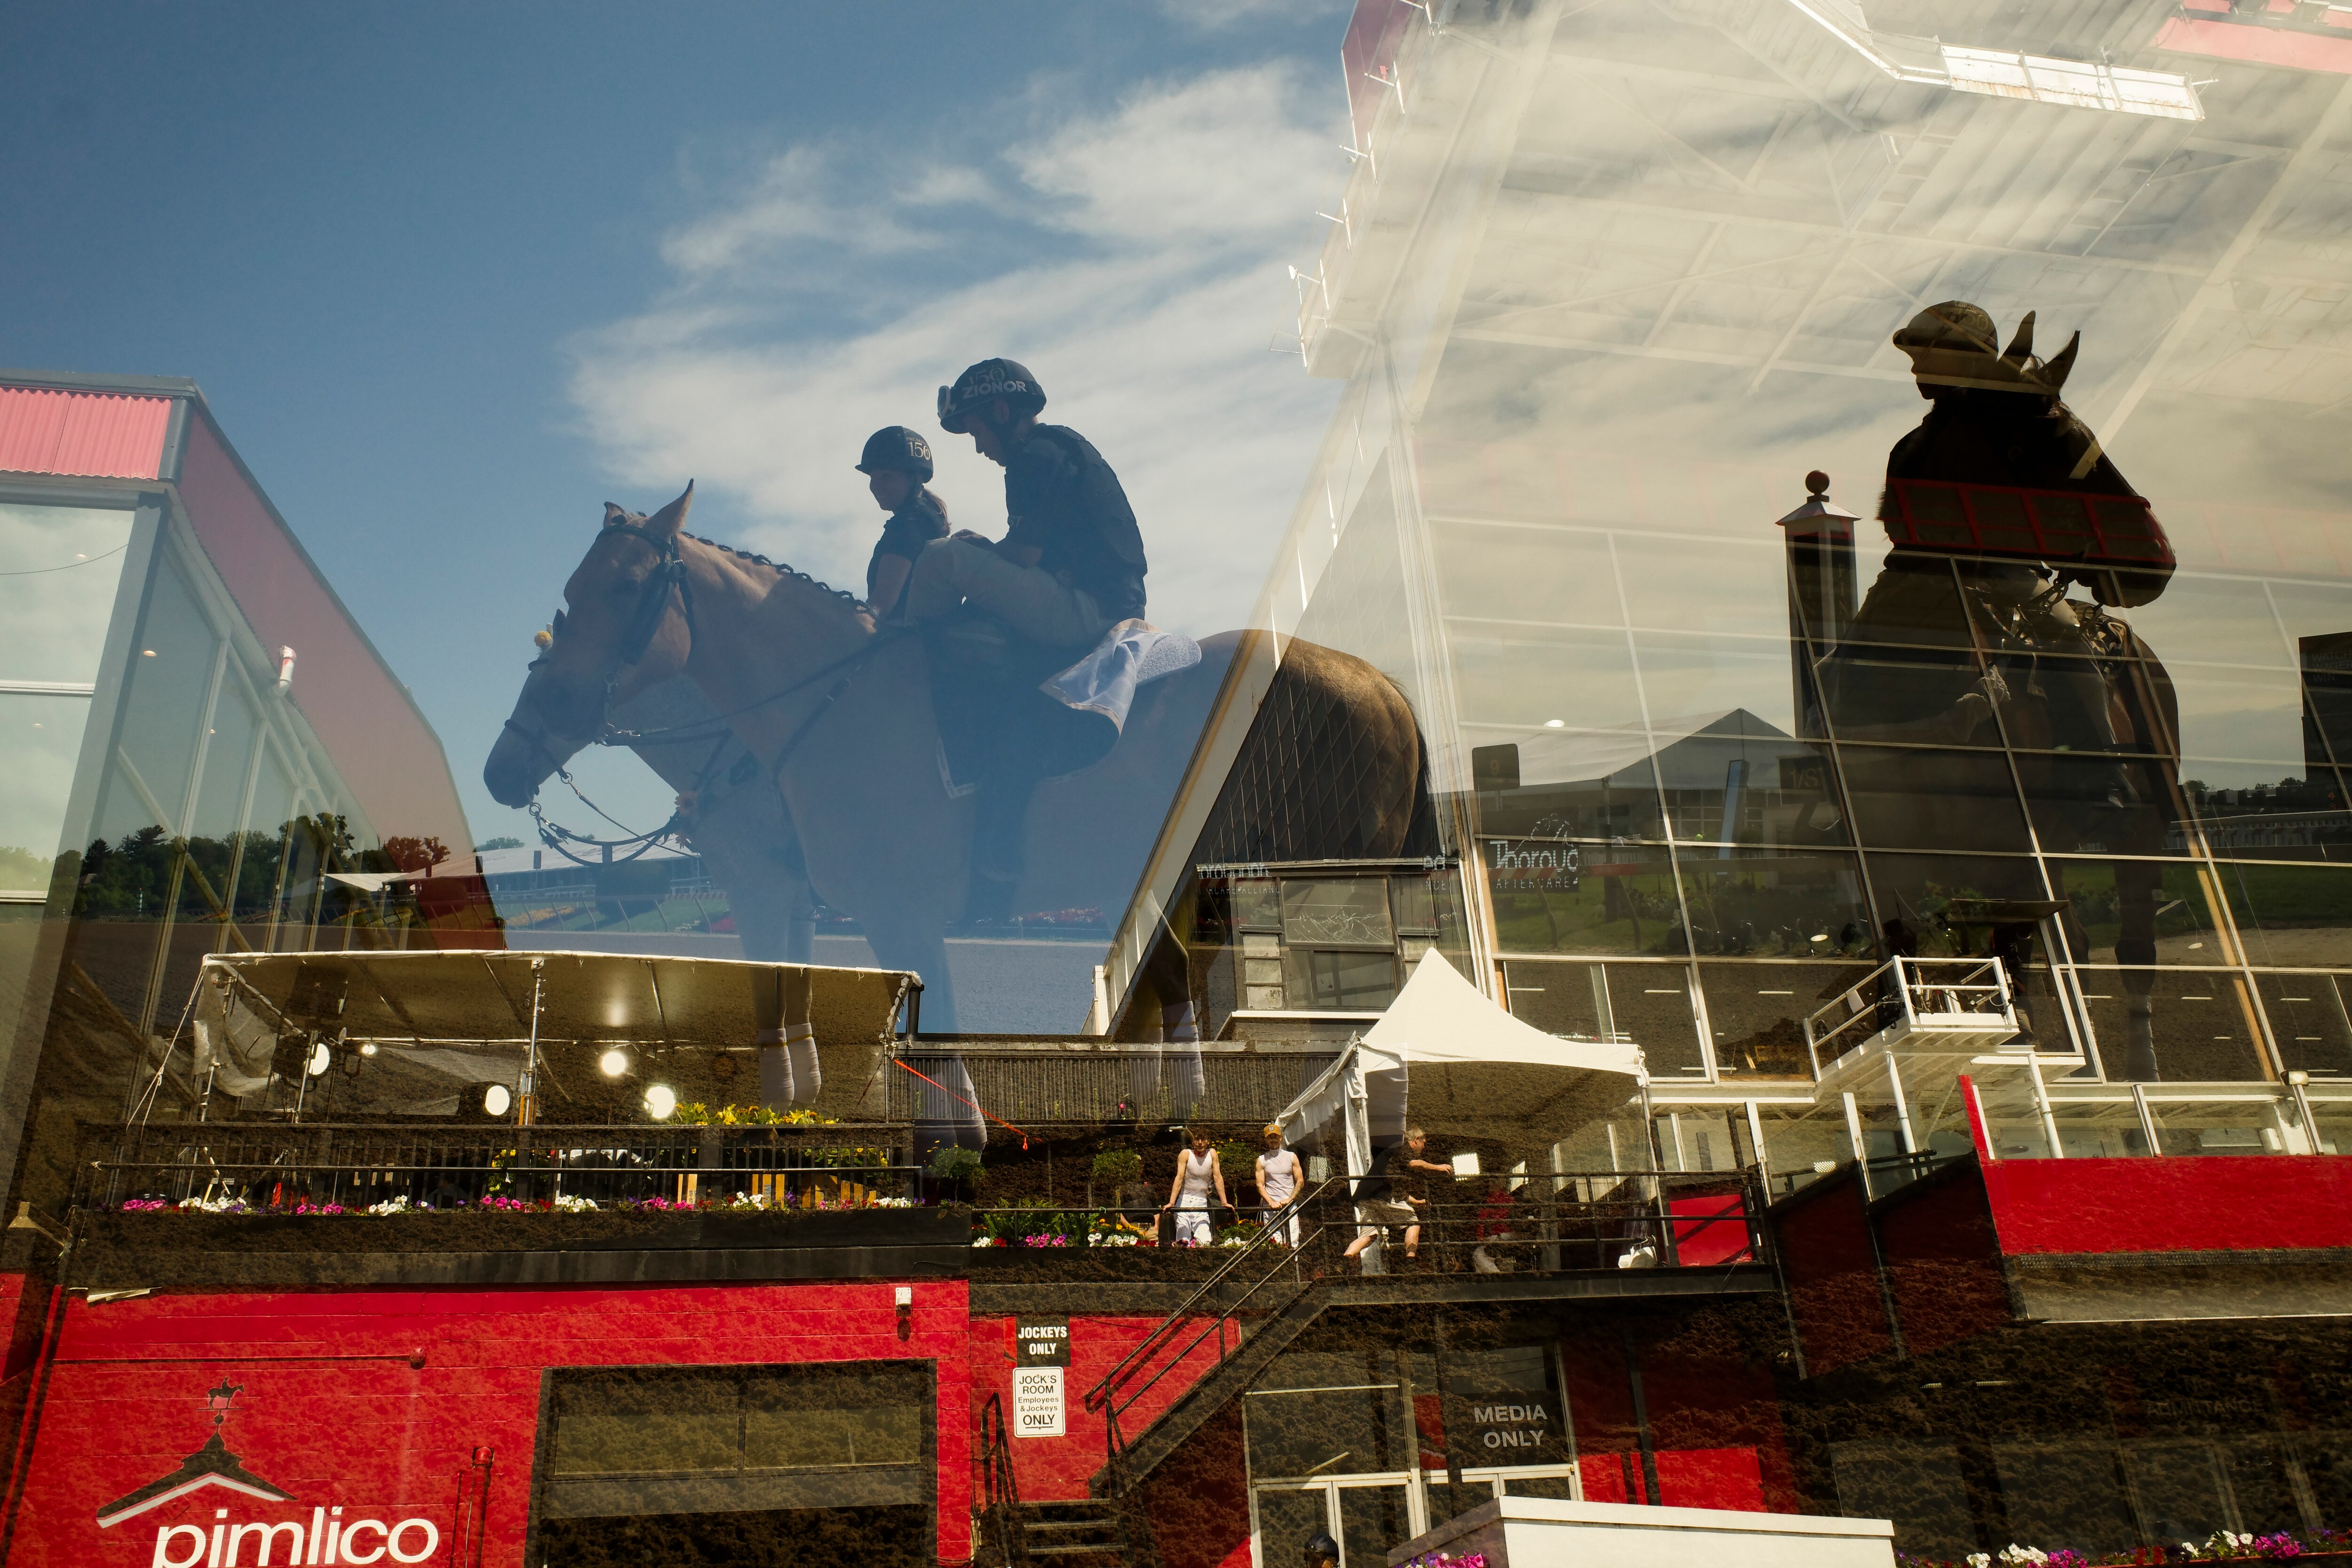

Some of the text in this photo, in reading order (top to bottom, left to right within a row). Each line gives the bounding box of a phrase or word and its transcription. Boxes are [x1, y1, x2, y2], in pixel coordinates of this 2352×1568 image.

[962, 381, 1028, 399] ZIONOR
[907, 441, 931, 461] 150
[1018, 1326, 1067, 1339] JOCKEYS
[1029, 1343, 1057, 1355] ONLY
[1019, 1375, 1057, 1385] JOCK'S
[1023, 1385, 1054, 1394] ROOM
[1023, 1414, 1055, 1425] ONLY
[1474, 1404, 1548, 1423] MEDIA
[1483, 1430, 1544, 1449] ONLY
[152, 1506, 438, 1568] pimlico
